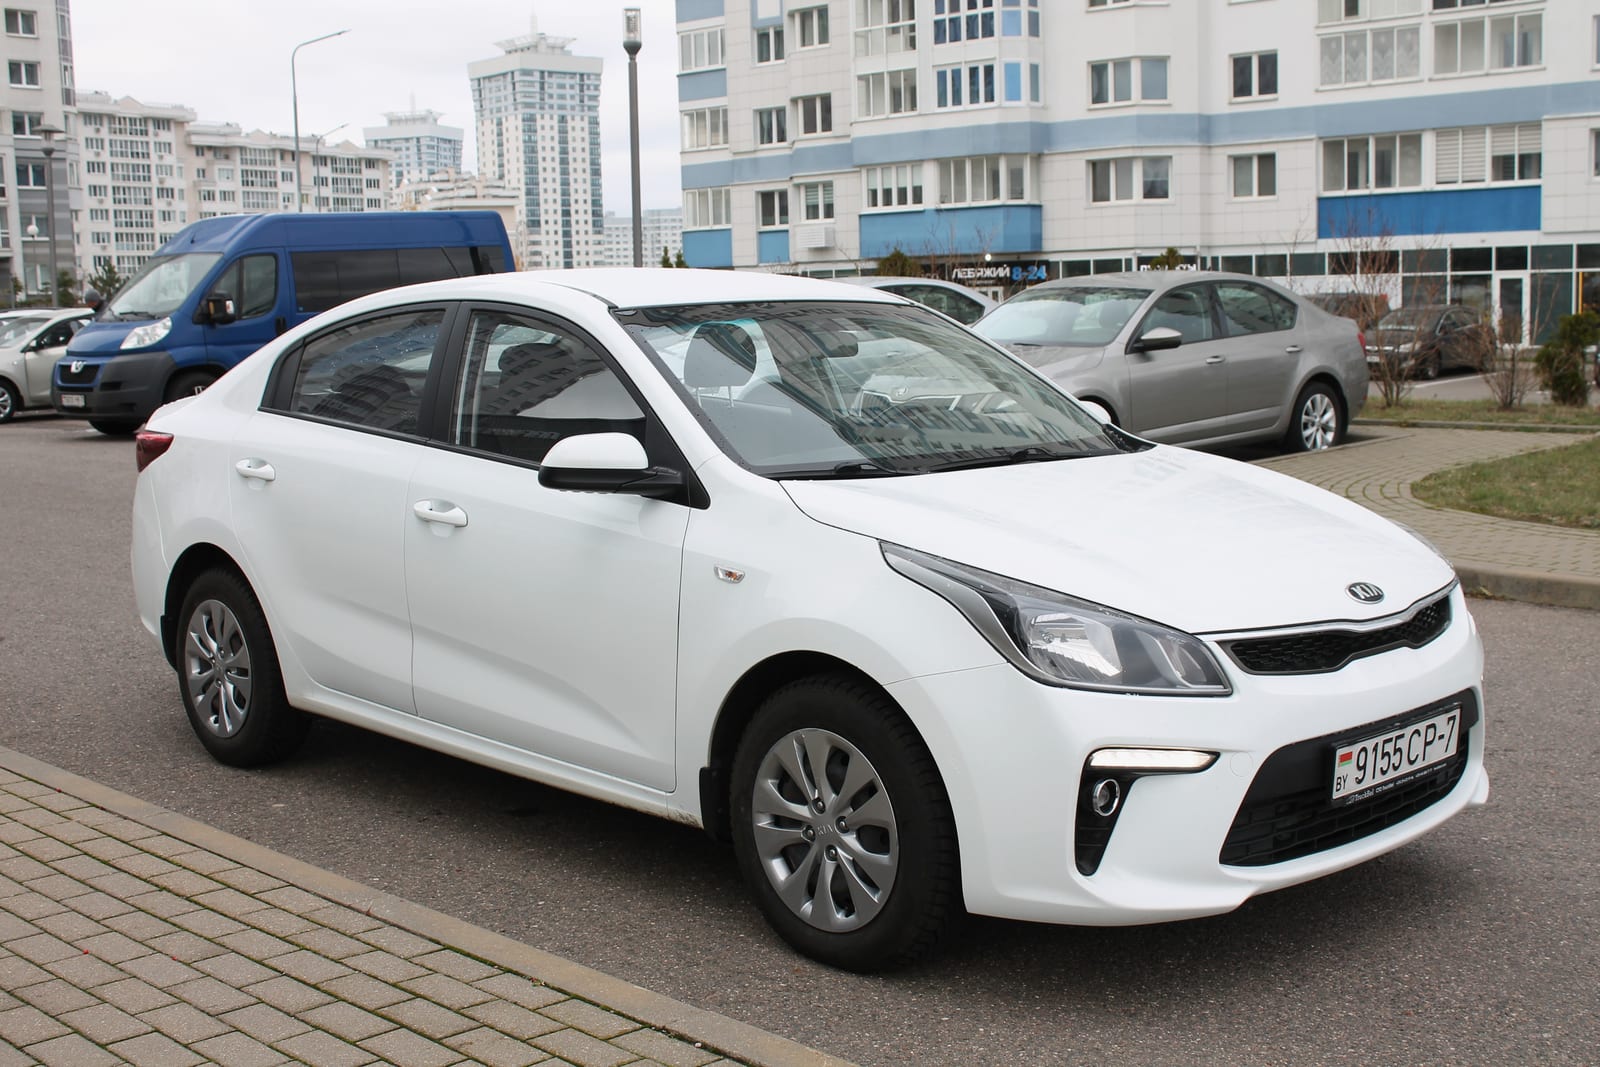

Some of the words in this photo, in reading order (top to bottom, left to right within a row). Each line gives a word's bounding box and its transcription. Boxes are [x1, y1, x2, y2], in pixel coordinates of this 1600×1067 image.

[952, 264, 1010, 279] ЛЕБЯЖИЙ
[1012, 265, 1047, 281] 8-24
[1335, 774, 1348, 792] BY
